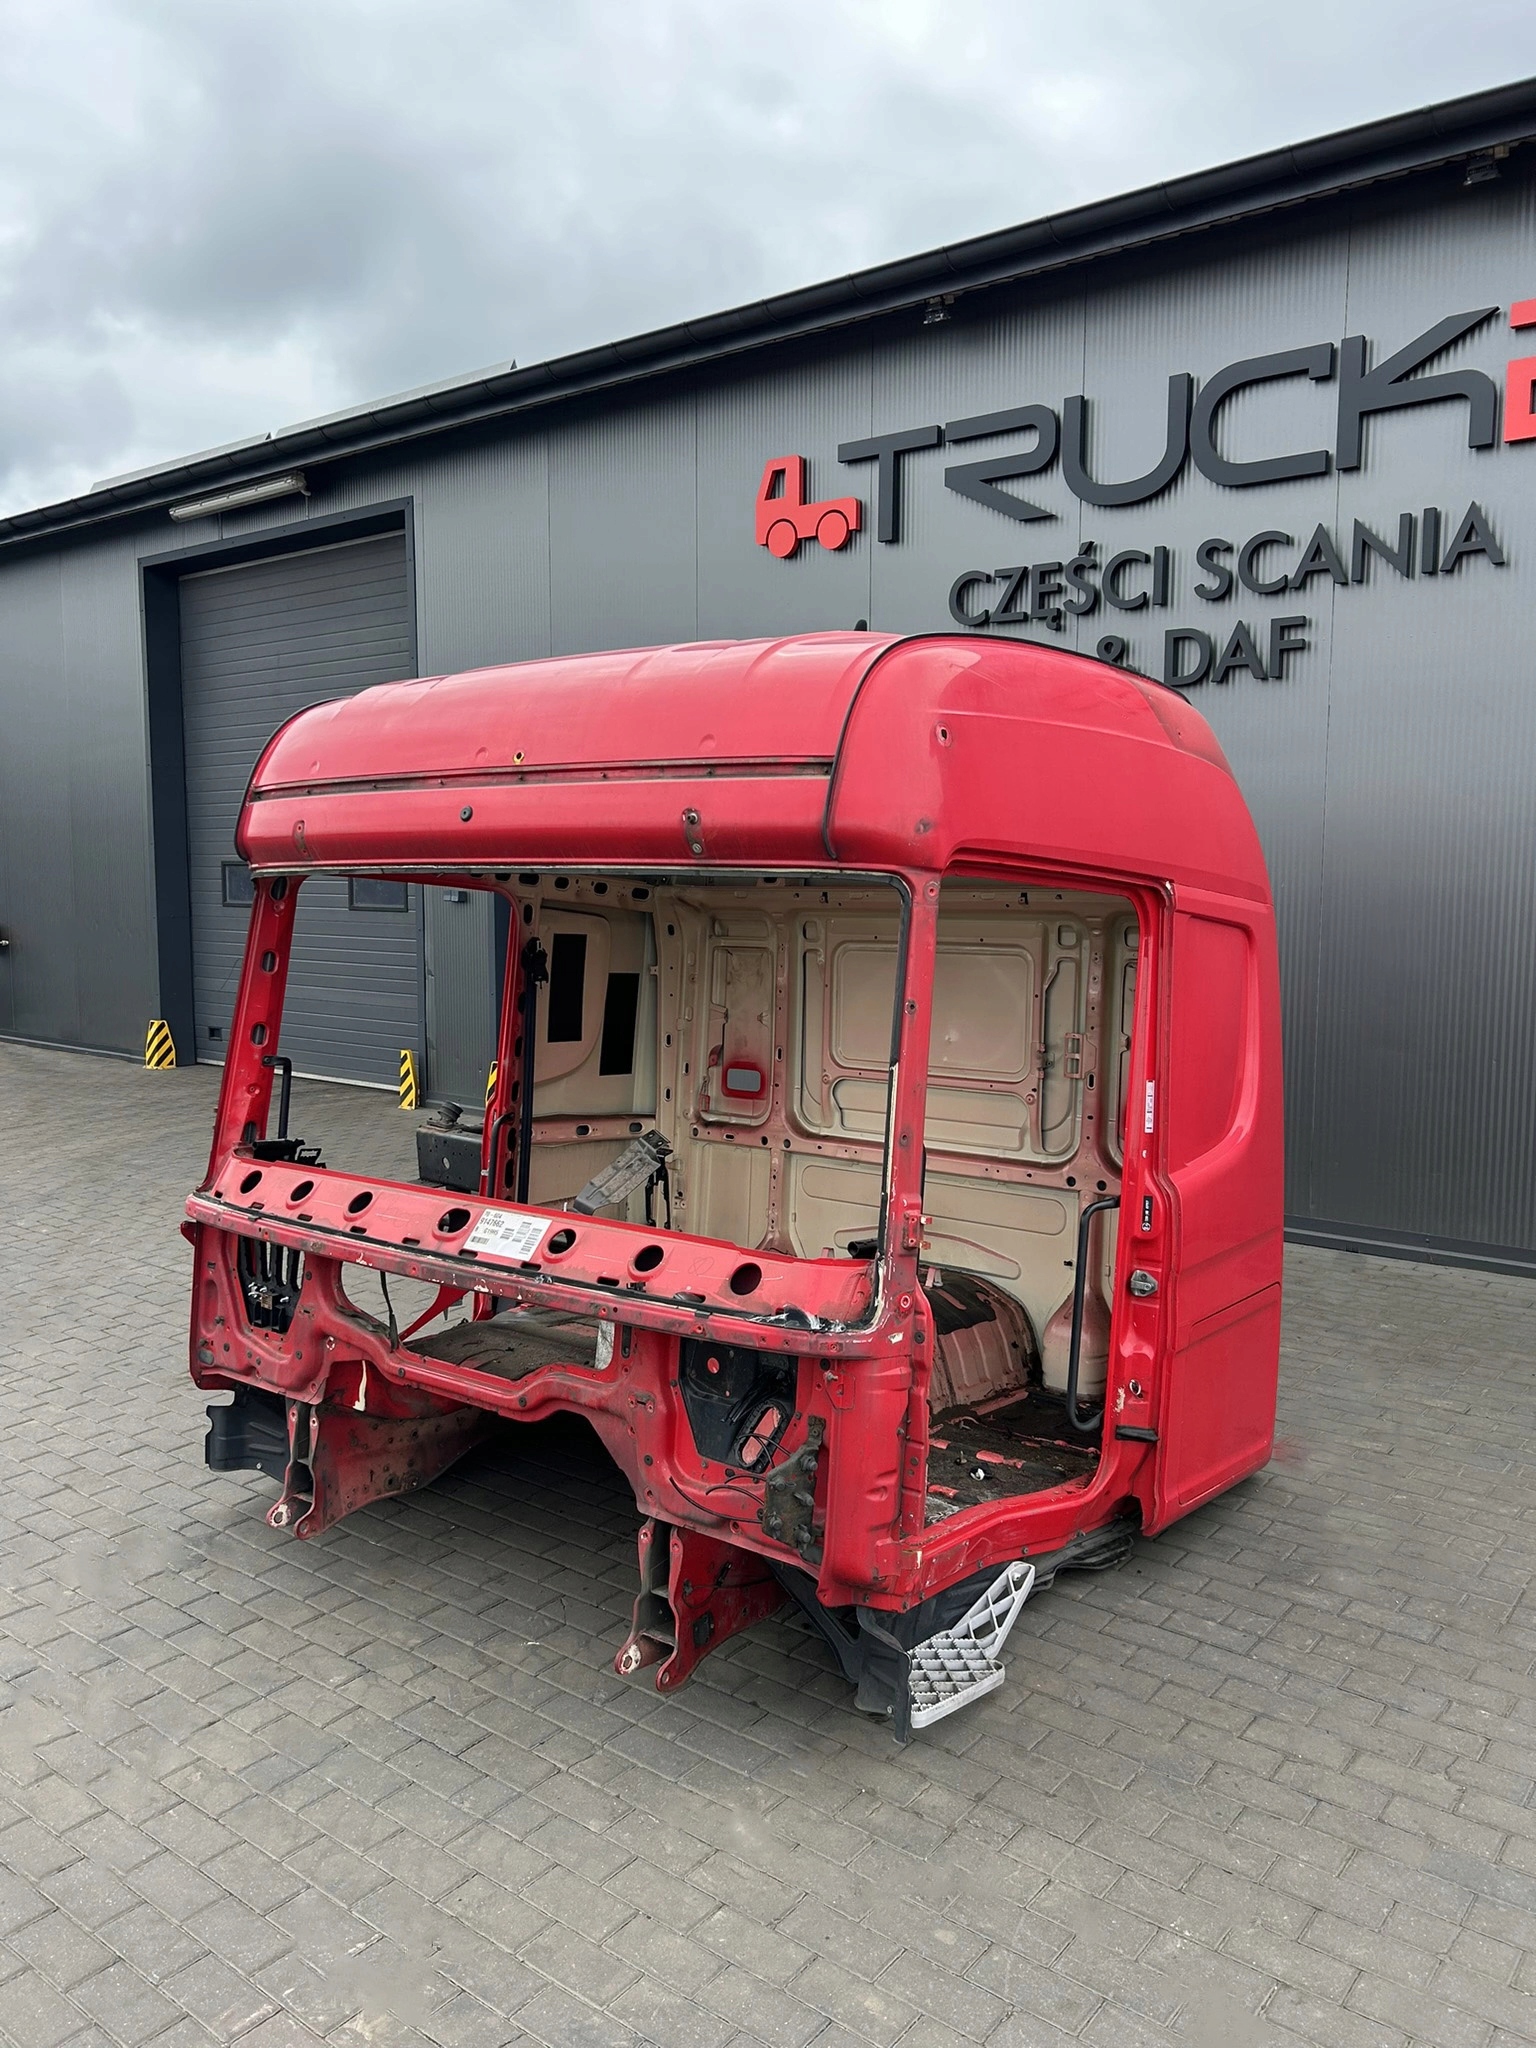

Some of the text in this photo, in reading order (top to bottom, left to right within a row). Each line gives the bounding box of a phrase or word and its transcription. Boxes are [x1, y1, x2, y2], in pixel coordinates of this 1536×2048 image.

[838, 298, 1536, 545] TRUCK
[948, 500, 1505, 632] CZĘŚCI SCANIA
[1163, 615, 1308, 686] DAF
